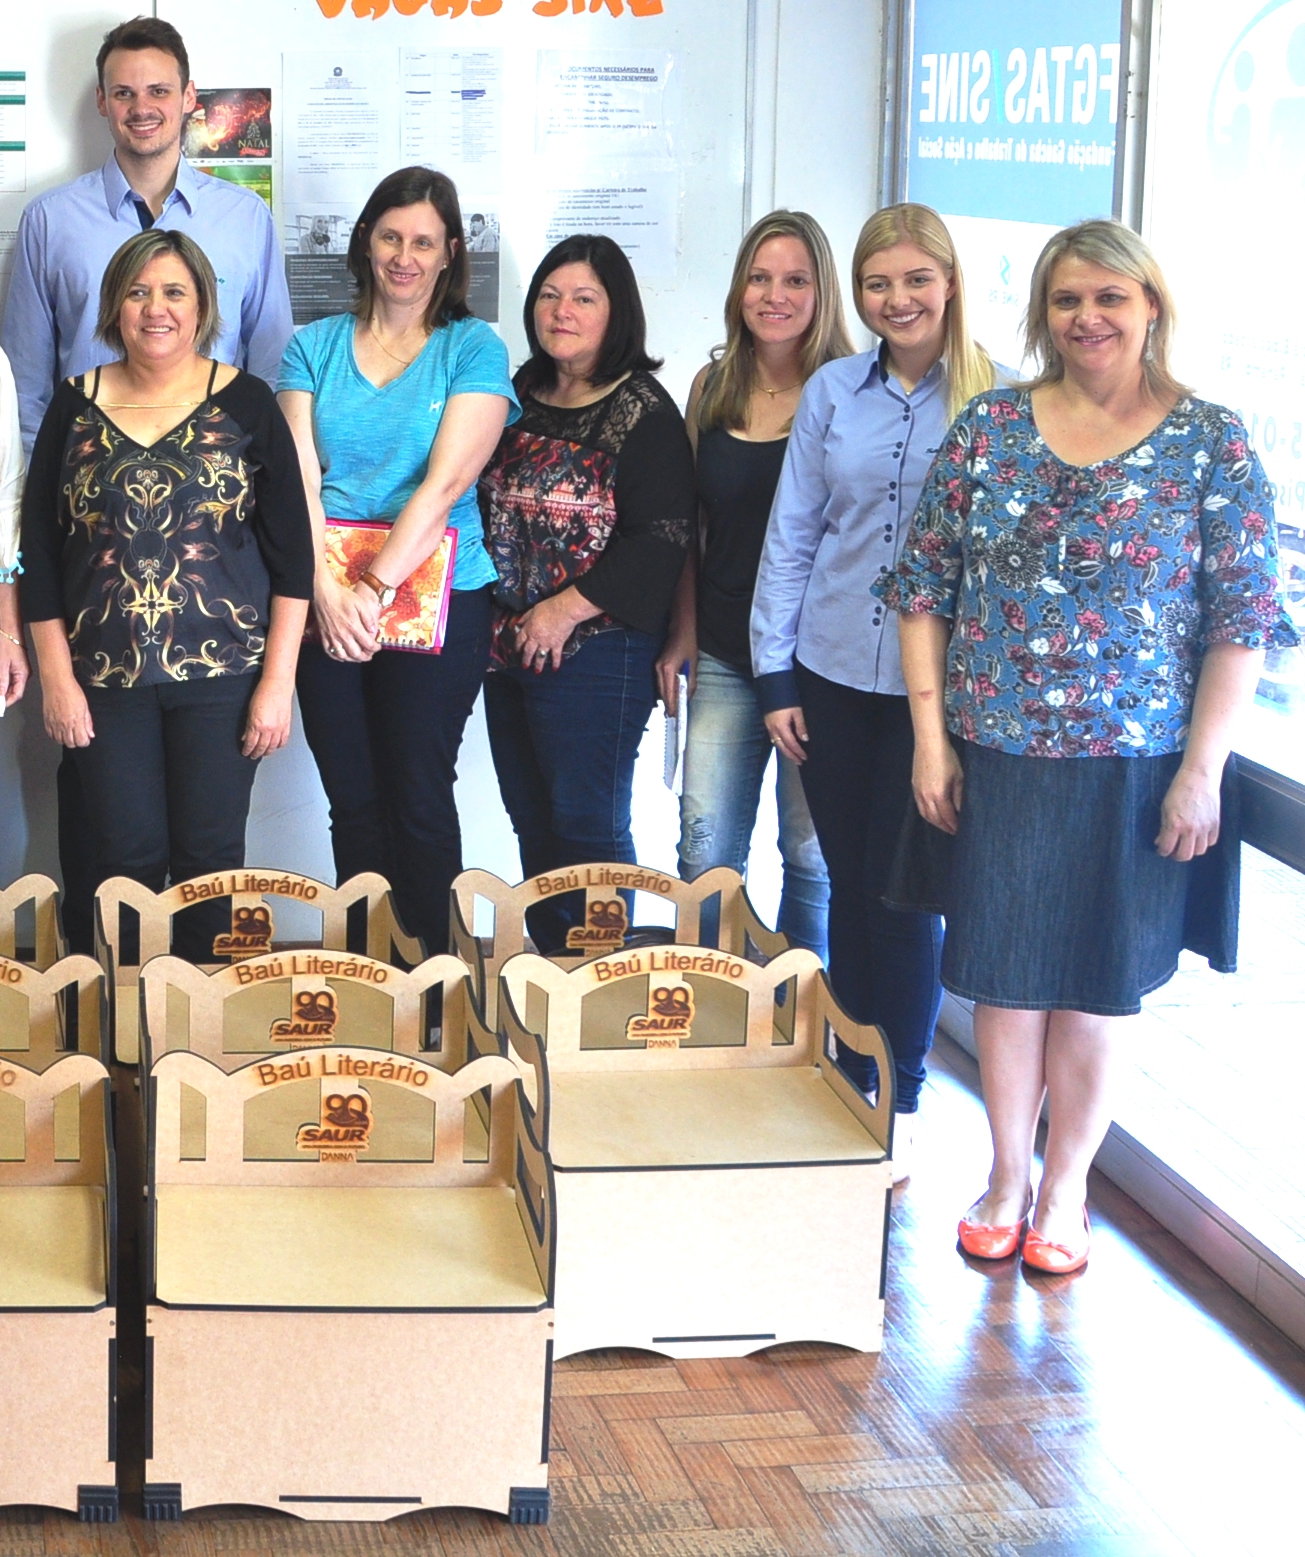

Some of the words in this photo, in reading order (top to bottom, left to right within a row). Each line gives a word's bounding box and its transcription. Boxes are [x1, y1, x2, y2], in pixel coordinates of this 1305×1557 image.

[238, 139, 270, 148] NATAL
[179, 877, 225, 902] Baú
[230, 874, 318, 900] Literário
[535, 870, 580, 895] Baú
[586, 868, 672, 894] Literário
[570, 930, 622, 941] SAUR
[217, 936, 269, 949] SAUR
[235, 958, 283, 985] Baú
[293, 955, 388, 984] Literário
[594, 954, 642, 982] Baú
[650, 951, 744, 979] Literário
[274, 1023, 333, 1035] SAUR
[631, 1018, 688, 1031] SAUR
[257, 1056, 313, 1087] Baú
[321, 1054, 429, 1087] Literário
[302, 1128, 367, 1142] SAUR
[321, 1152, 354, 1162] DANNA
